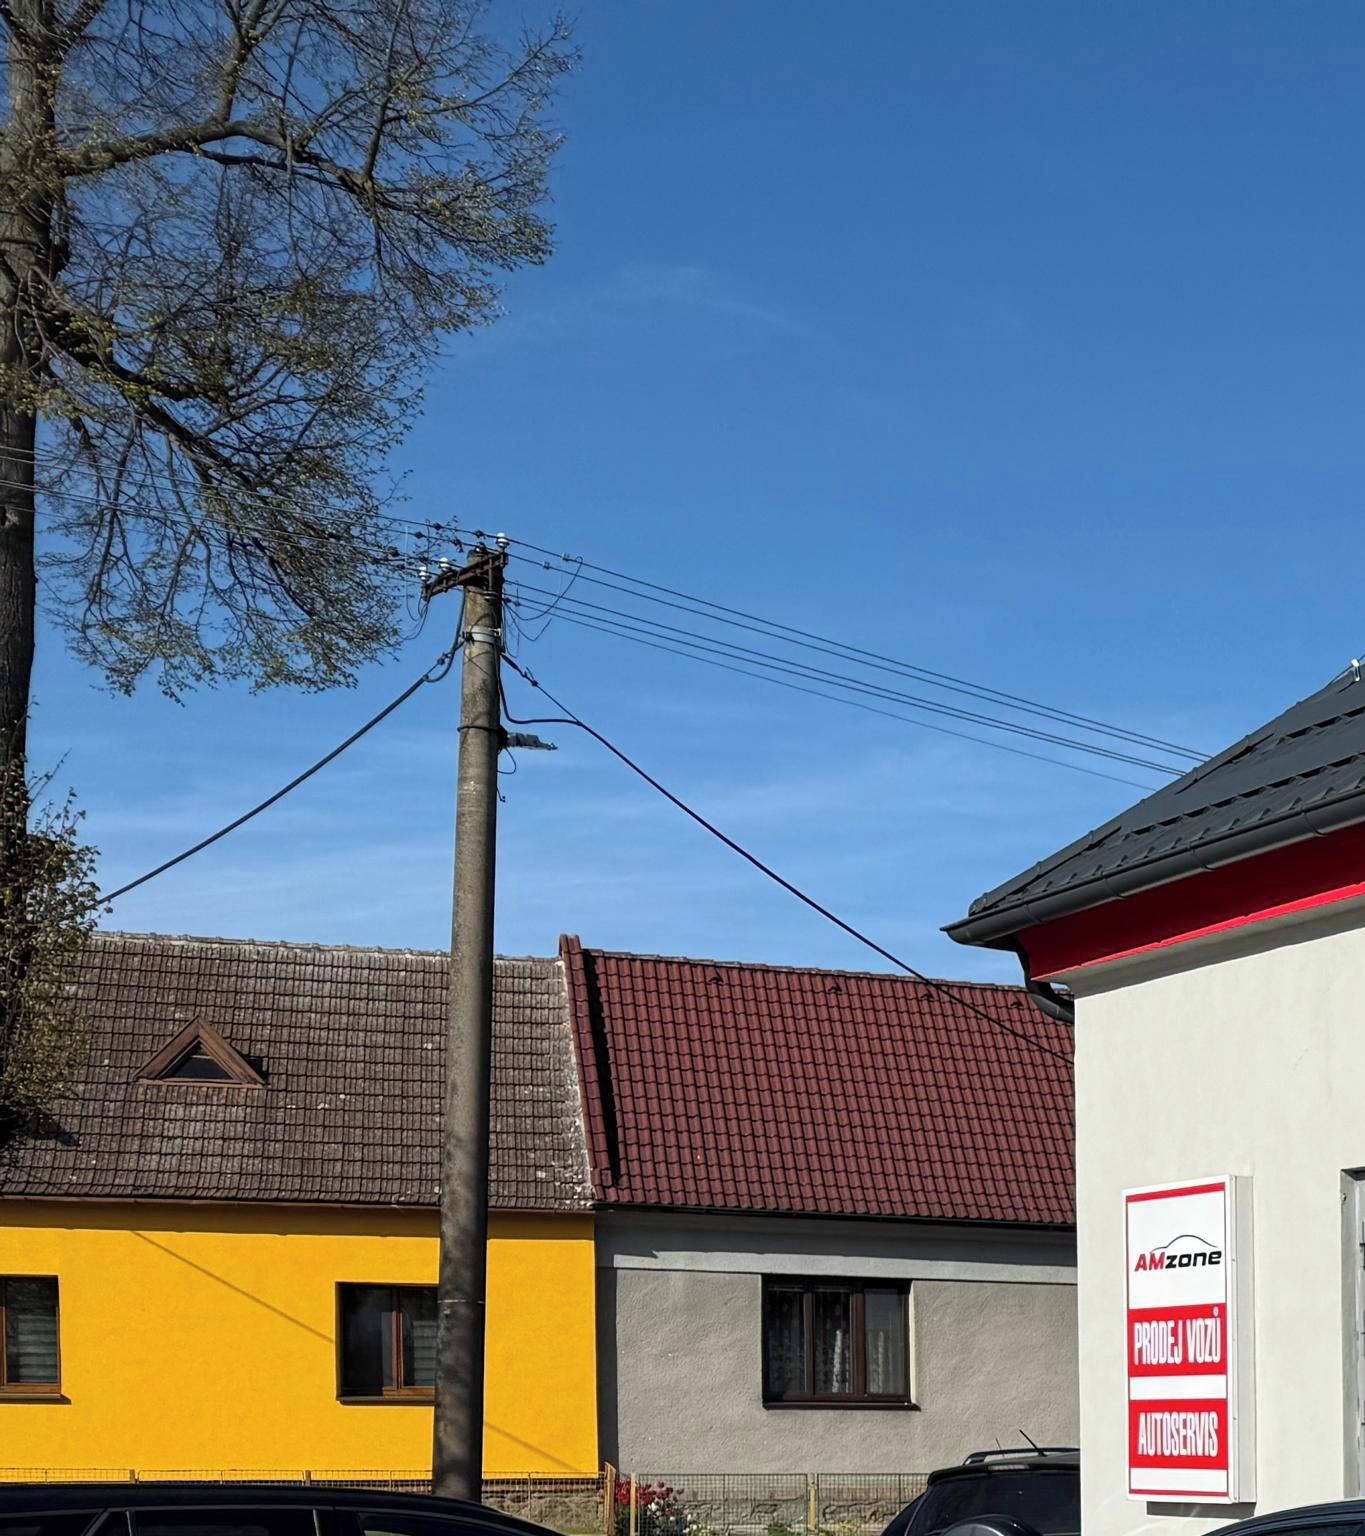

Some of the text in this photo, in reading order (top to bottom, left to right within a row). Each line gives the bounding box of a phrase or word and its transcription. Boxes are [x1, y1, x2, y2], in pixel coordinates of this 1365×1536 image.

[1134, 1249, 1223, 1273] AMzone
[1133, 1306, 1222, 1366] PRODEJ VOZŮ
[1138, 1410, 1219, 1458] AUTOSERVIS
